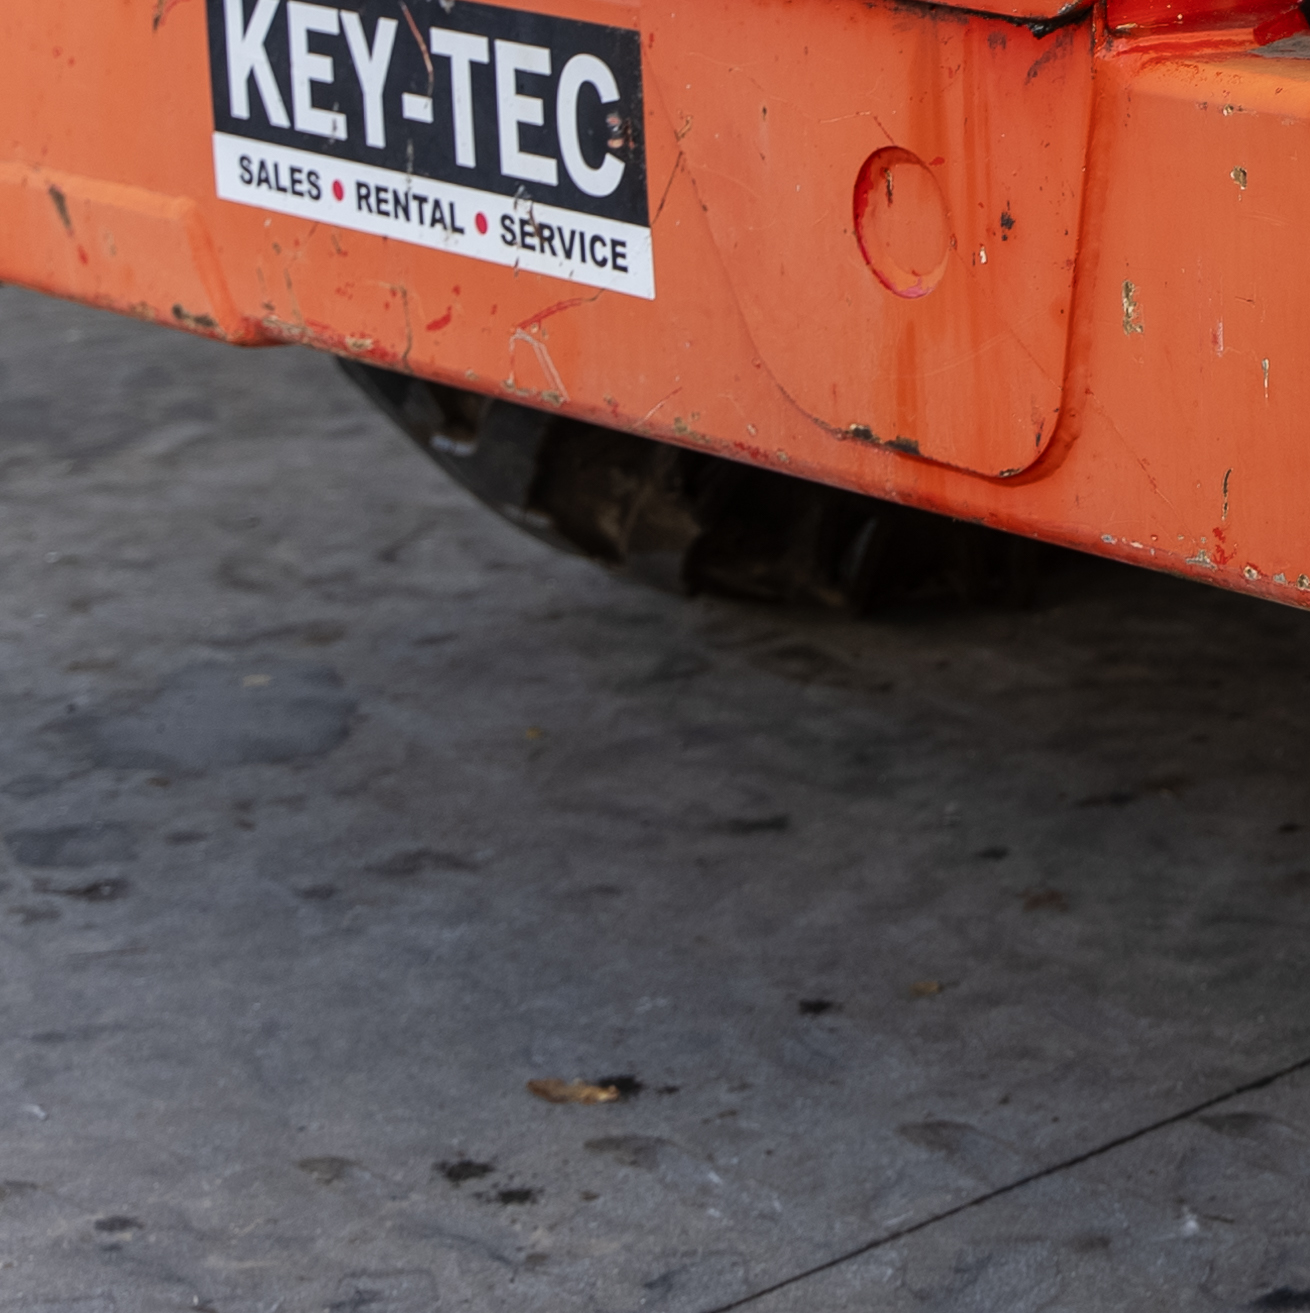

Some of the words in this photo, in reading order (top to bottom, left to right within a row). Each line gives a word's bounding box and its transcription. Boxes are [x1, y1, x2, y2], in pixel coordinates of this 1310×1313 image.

[238, 154, 322, 201] SALES
[356, 180, 465, 235] RENTAL
[499, 212, 629, 274] SERVICE
